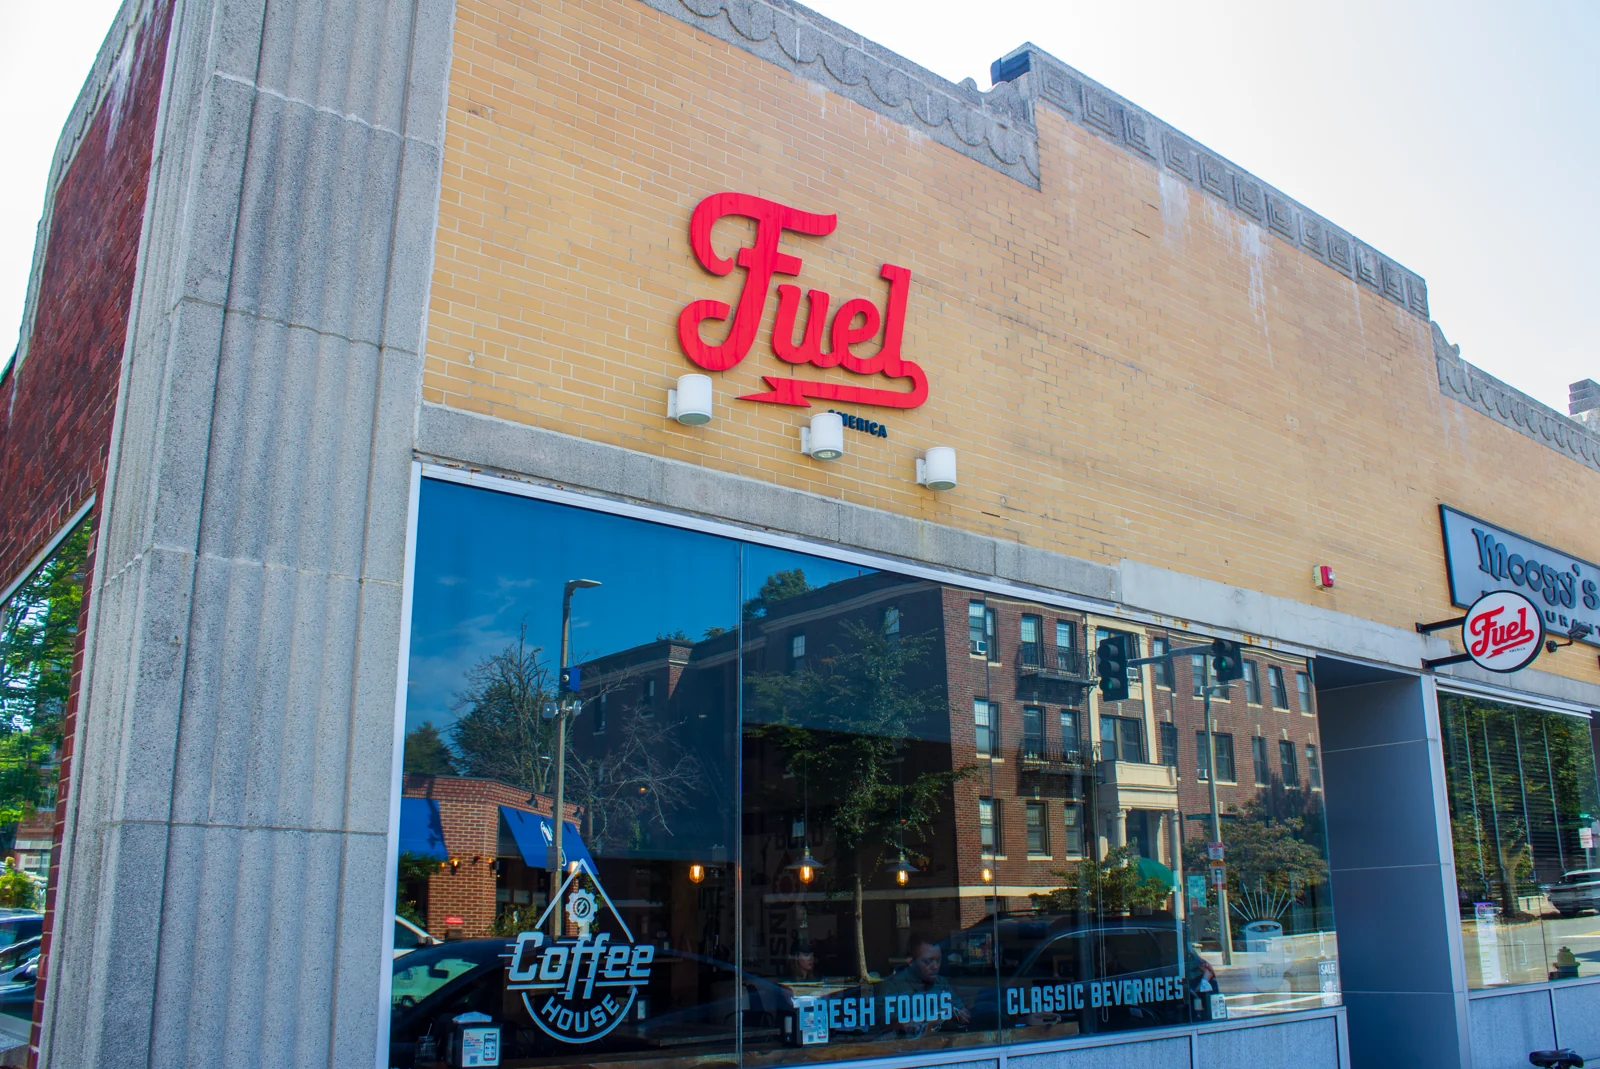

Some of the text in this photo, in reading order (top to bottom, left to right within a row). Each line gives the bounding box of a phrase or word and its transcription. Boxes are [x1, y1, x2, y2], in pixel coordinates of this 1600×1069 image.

[677, 192, 929, 408] Fuel
[828, 409, 888, 439] MERICA
[1471, 528, 1600, 610] Moogy's
[1469, 605, 1535, 659] Fuel
[497, 931, 655, 1000] Coffee
[1320, 964, 1335, 975] SALE
[540, 993, 620, 1033] HOUSE
[799, 996, 875, 1031] FRESH
[884, 991, 953, 1025] FOODS
[1006, 975, 1184, 1015] CLASSIC BEVERAGES
